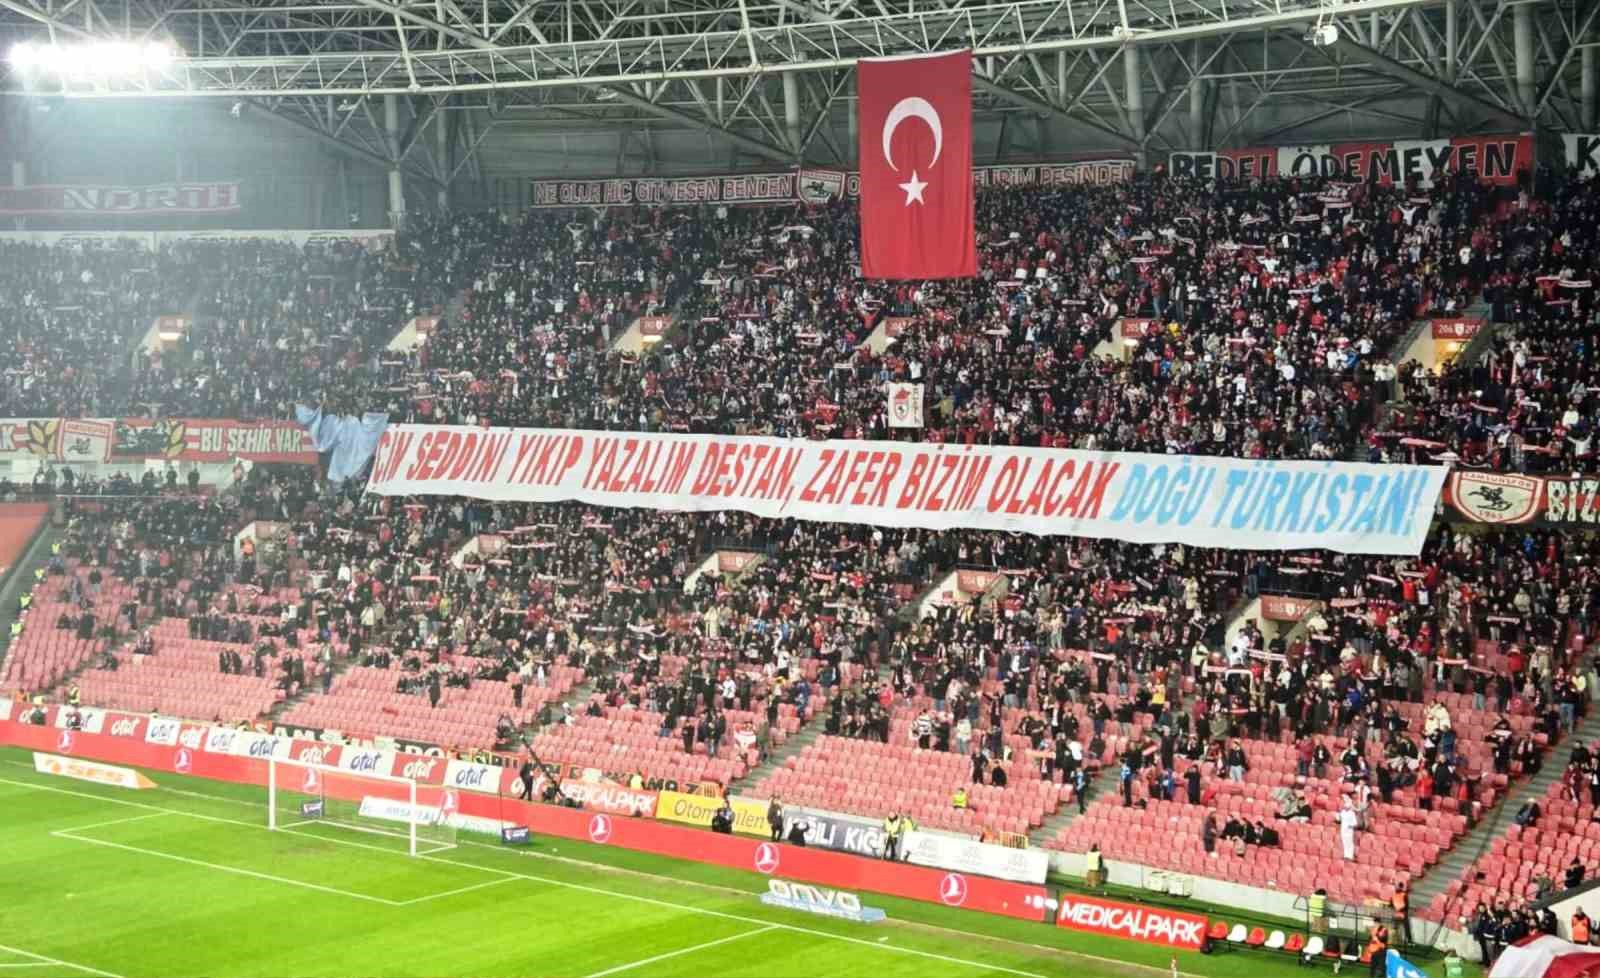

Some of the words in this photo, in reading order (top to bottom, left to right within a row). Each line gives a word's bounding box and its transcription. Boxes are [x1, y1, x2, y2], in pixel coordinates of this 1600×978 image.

[1291, 141, 1516, 183] ÖDEMEYEN
[64, 184, 240, 209] NORTH
[723, 175, 793, 200] BENDEN
[507, 433, 584, 486] YIKIP
[582, 438, 698, 494] YAZALIM
[690, 441, 803, 512] DESTAN,
[800, 449, 902, 507] ZAFER
[896, 444, 992, 511] BİZİM
[987, 455, 1121, 519] OLACAK
[1109, 456, 1216, 526] DOĞU
[1211, 460, 1429, 537] TÜRKİSTAN!
[1060, 899, 1205, 944] MEDICALPARK
